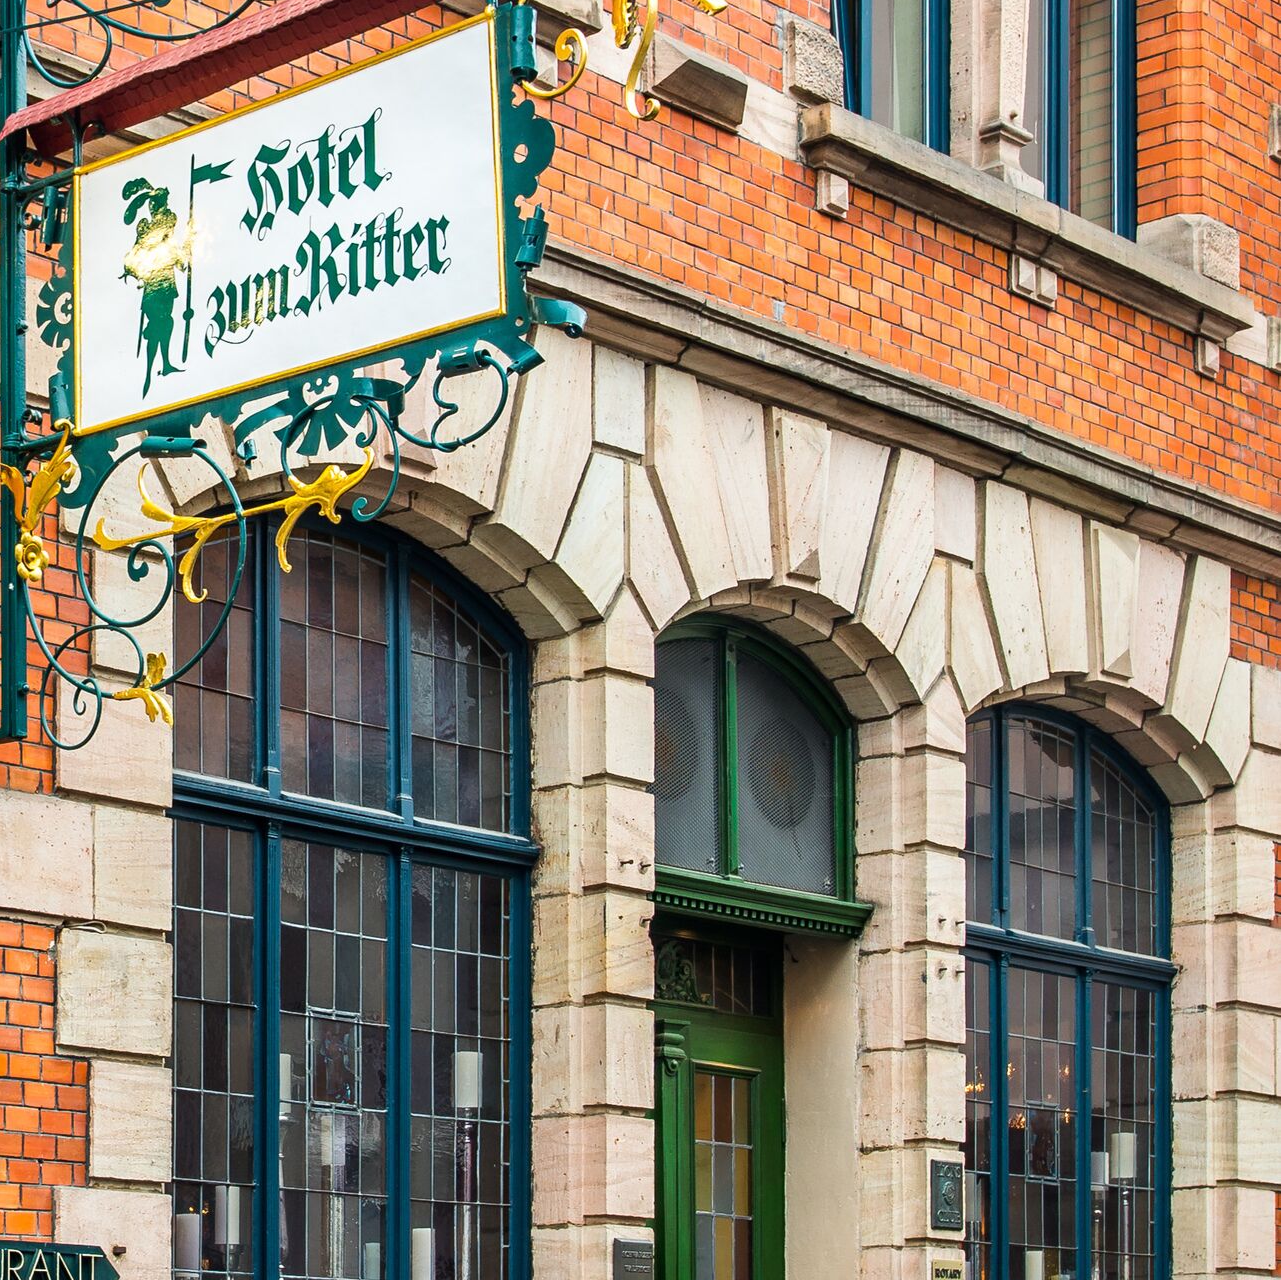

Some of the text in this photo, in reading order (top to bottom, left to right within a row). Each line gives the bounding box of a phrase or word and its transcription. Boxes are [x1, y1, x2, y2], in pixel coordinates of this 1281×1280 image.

[240, 107, 392, 241] Hotel
[205, 207, 451, 358] zum Ritter
[934, 1268, 962, 1280] ROTARY
